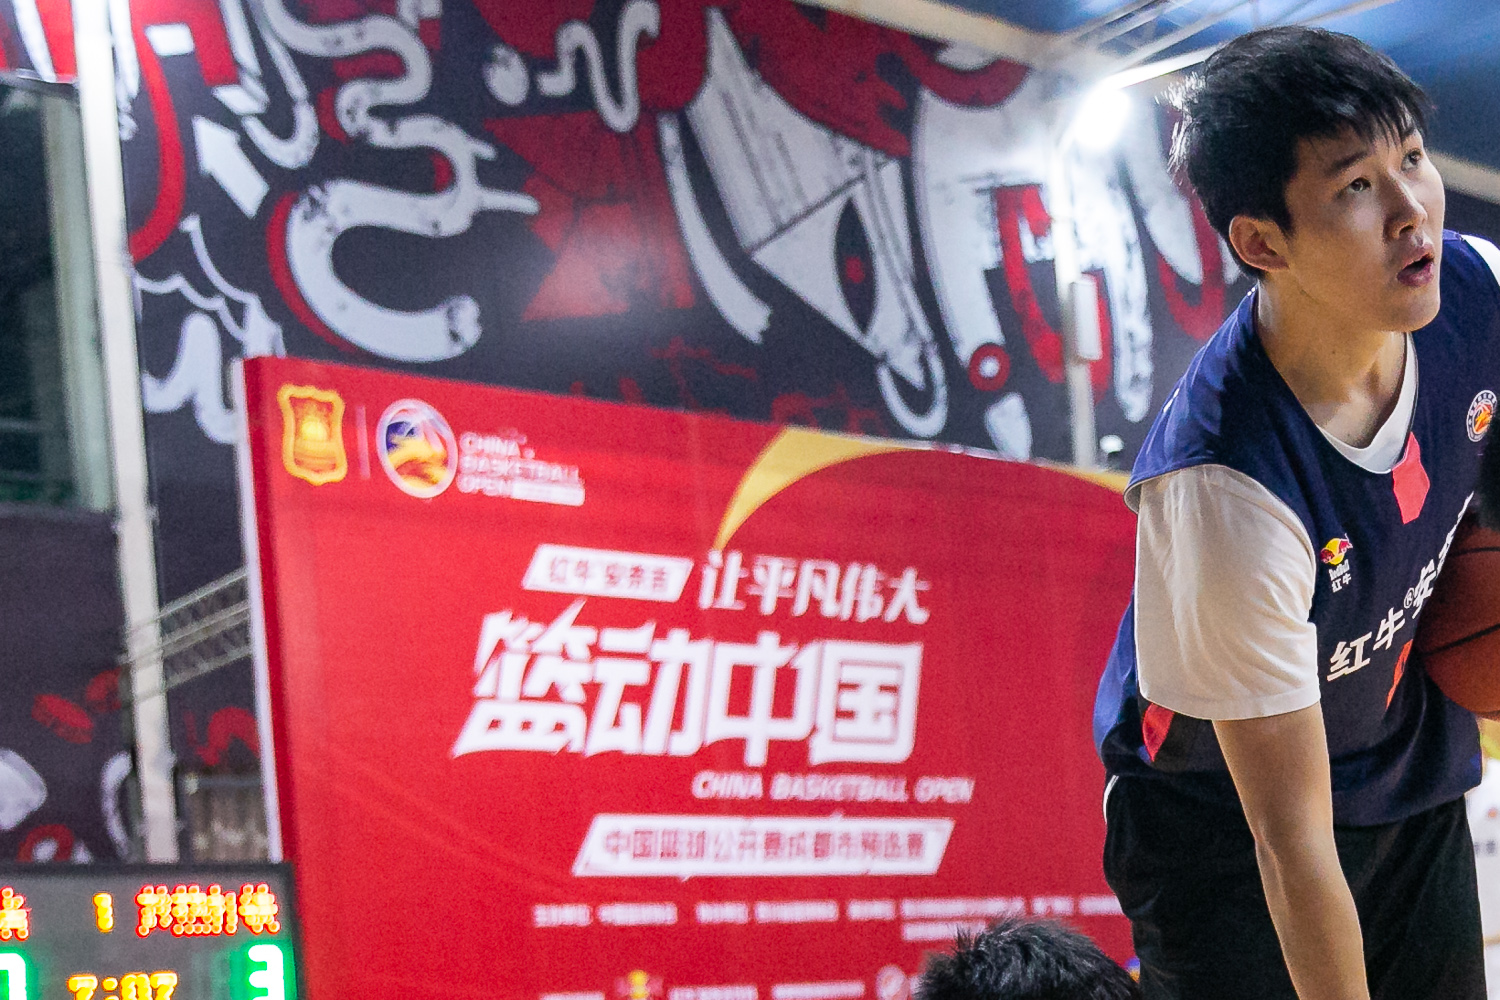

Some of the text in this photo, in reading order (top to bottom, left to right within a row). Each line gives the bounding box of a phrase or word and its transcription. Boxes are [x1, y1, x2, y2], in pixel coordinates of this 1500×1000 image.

[698, 550, 931, 625] 让平凡伟大
[452, 600, 924, 766] 篮动中国
[691, 770, 975, 804] CHINA BASKETBALL OPEN
